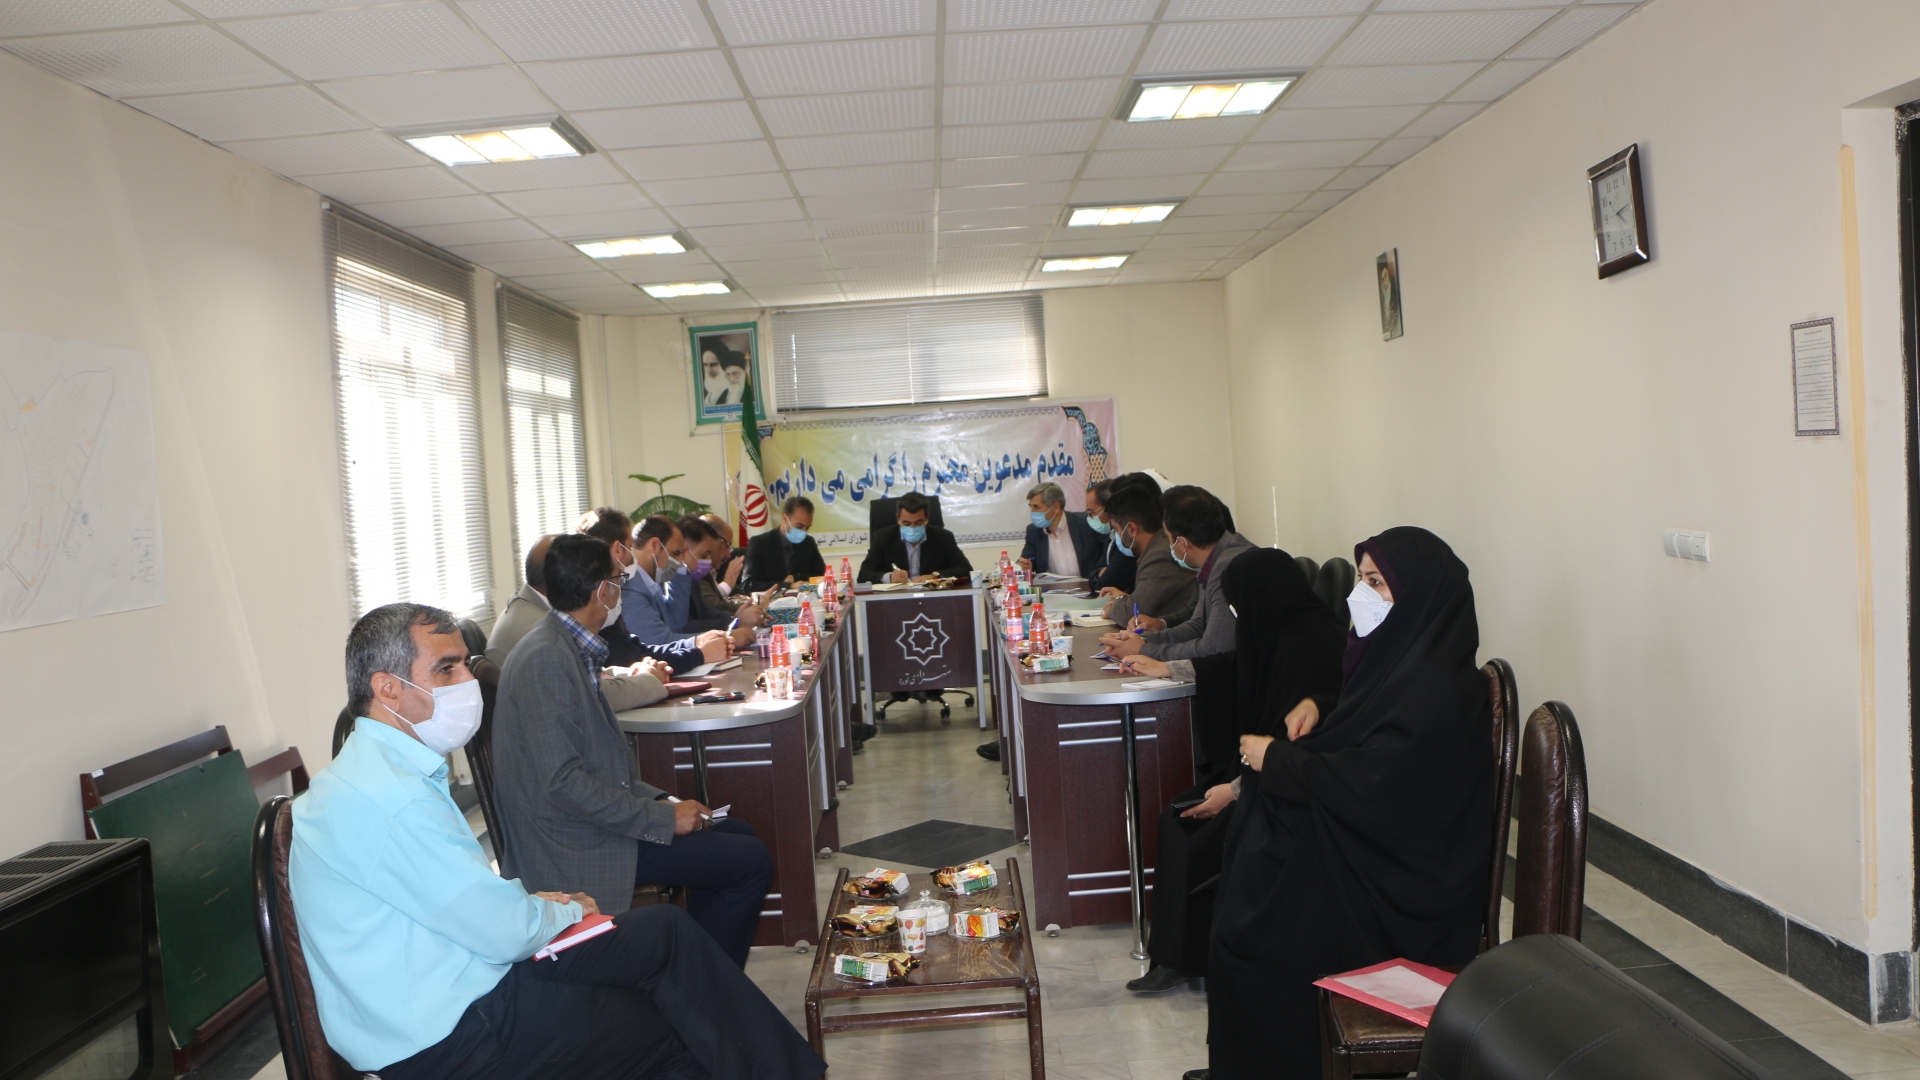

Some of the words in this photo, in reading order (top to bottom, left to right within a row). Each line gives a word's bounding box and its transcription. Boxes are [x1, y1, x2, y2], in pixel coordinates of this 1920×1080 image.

[850, 451, 897, 502] گرامی
[901, 450, 918, 493] را
[922, 454, 968, 496] محترم
[974, 452, 1032, 494] مدعوین
[1037, 442, 1074, 483] مقدم
[821, 469, 845, 504] می
[828, 533, 847, 546] اسلامی
[848, 532, 868, 545] شورای
[910, 664, 951, 685] شهرداری
